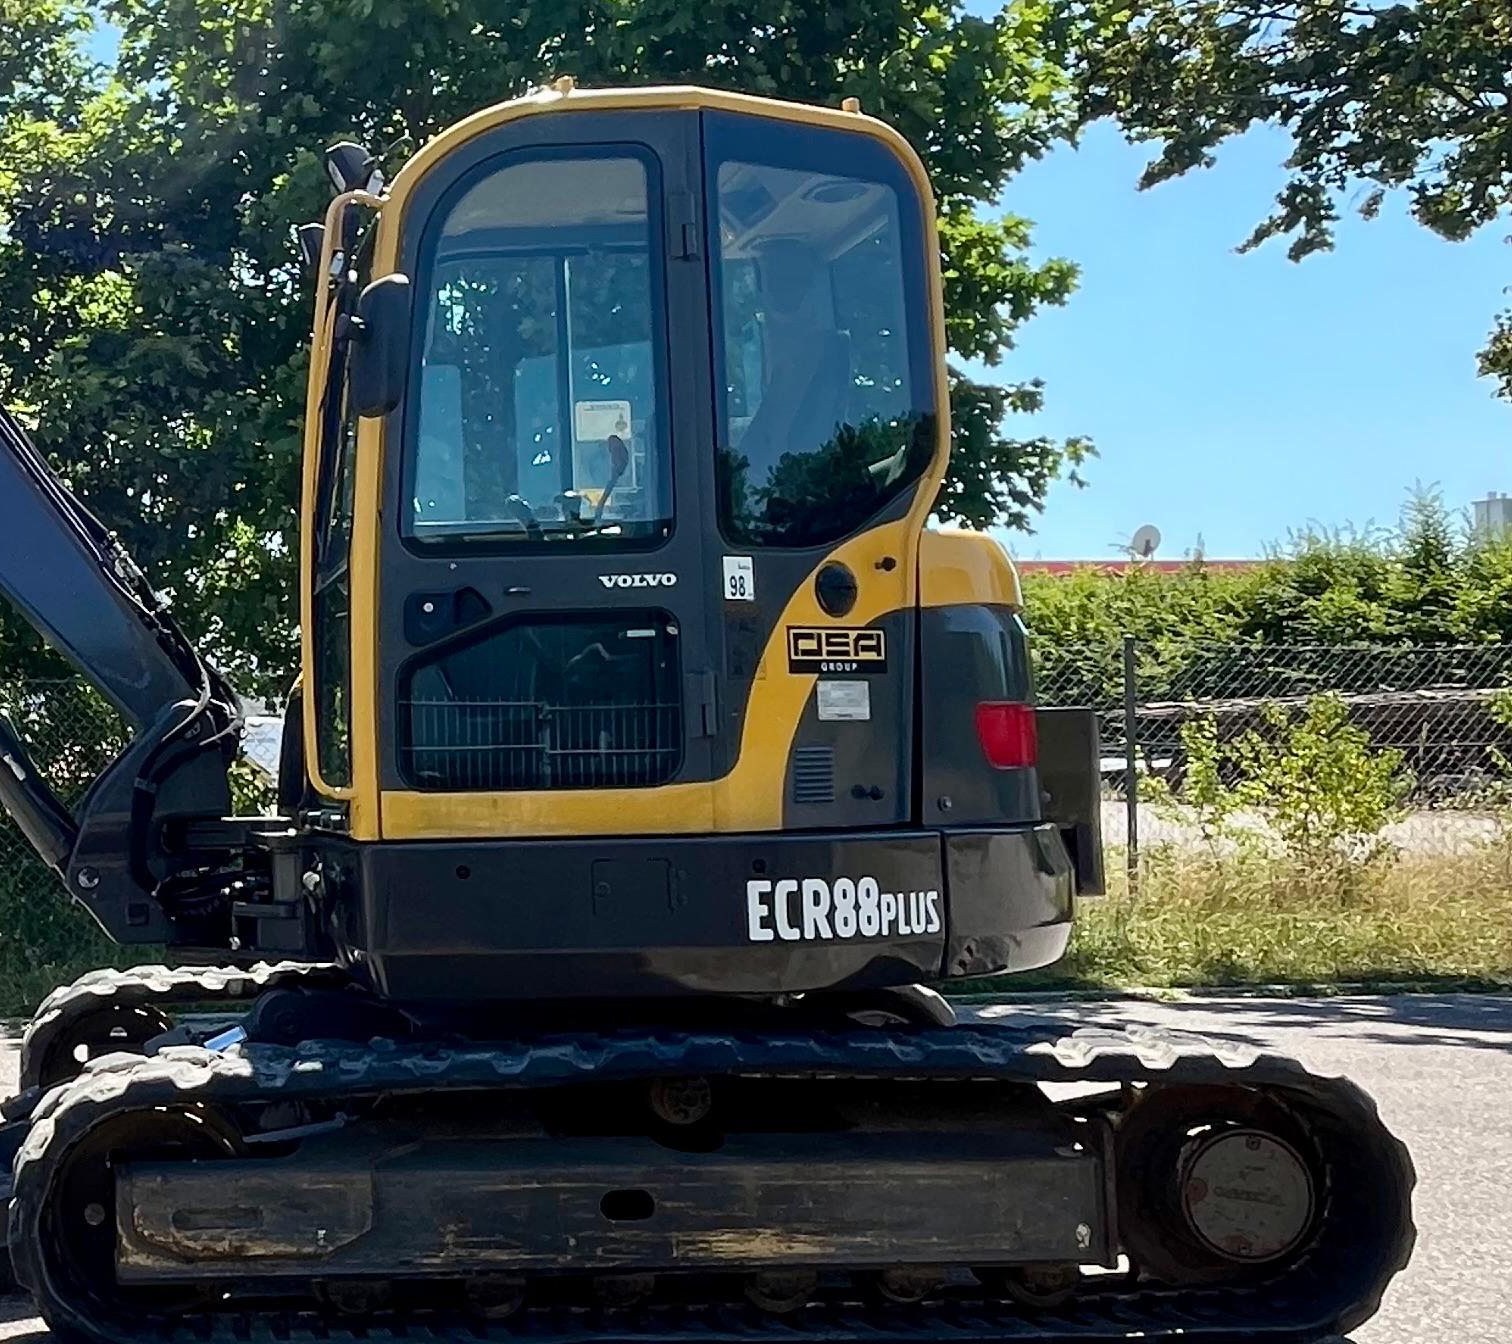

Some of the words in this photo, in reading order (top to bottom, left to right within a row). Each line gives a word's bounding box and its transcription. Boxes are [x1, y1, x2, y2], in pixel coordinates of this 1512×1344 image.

[598, 573, 676, 587] VOLVO
[730, 575, 745, 596] 98
[820, 662, 858, 671] GROUP
